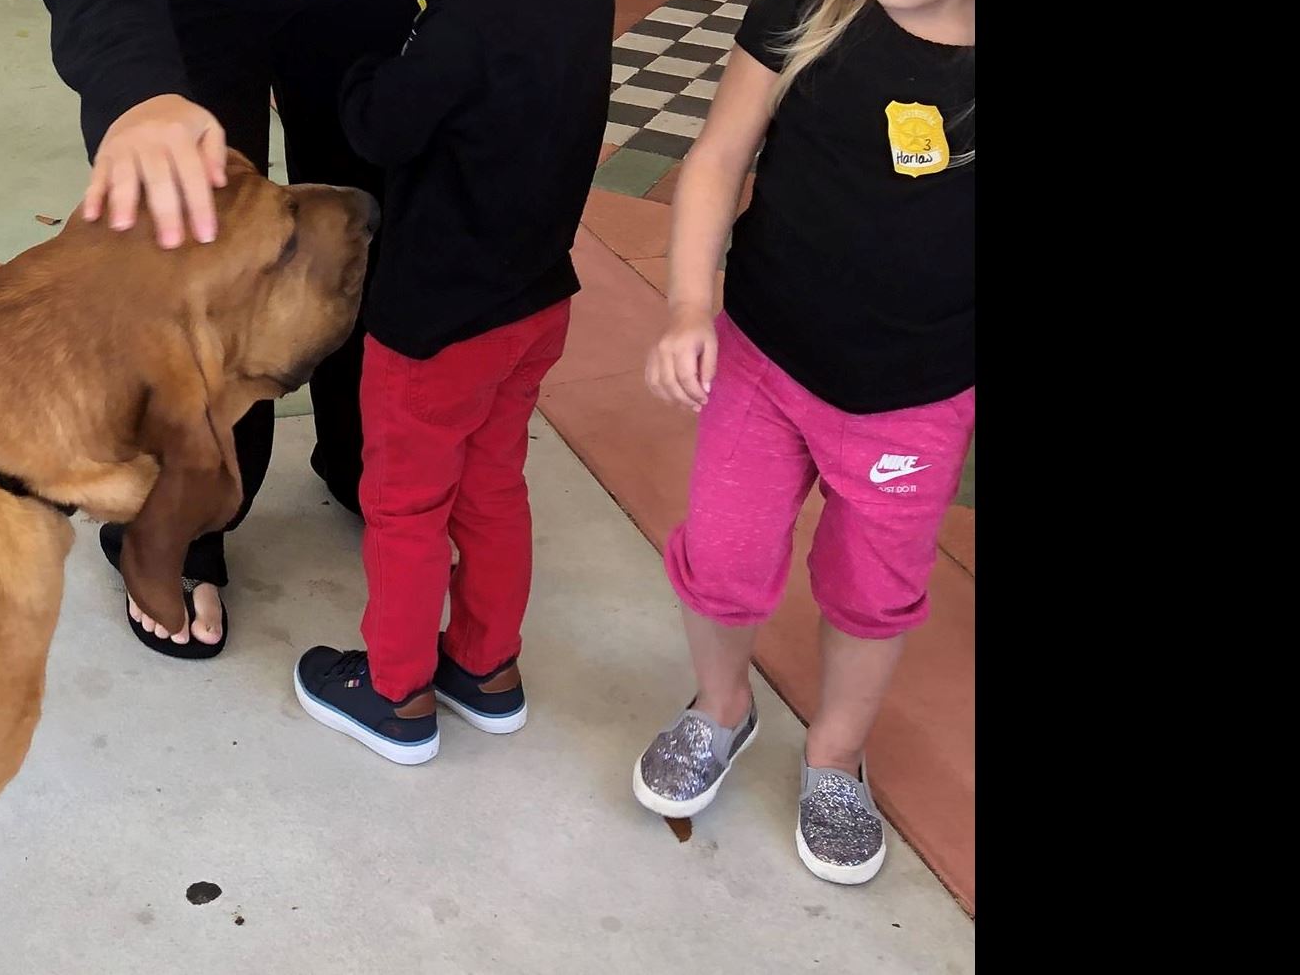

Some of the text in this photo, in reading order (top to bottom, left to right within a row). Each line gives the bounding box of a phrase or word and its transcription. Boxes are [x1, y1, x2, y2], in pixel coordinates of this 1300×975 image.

[923, 138, 931, 151] 3
[878, 453, 919, 471] NIKE
[897, 485, 909, 493] DO
